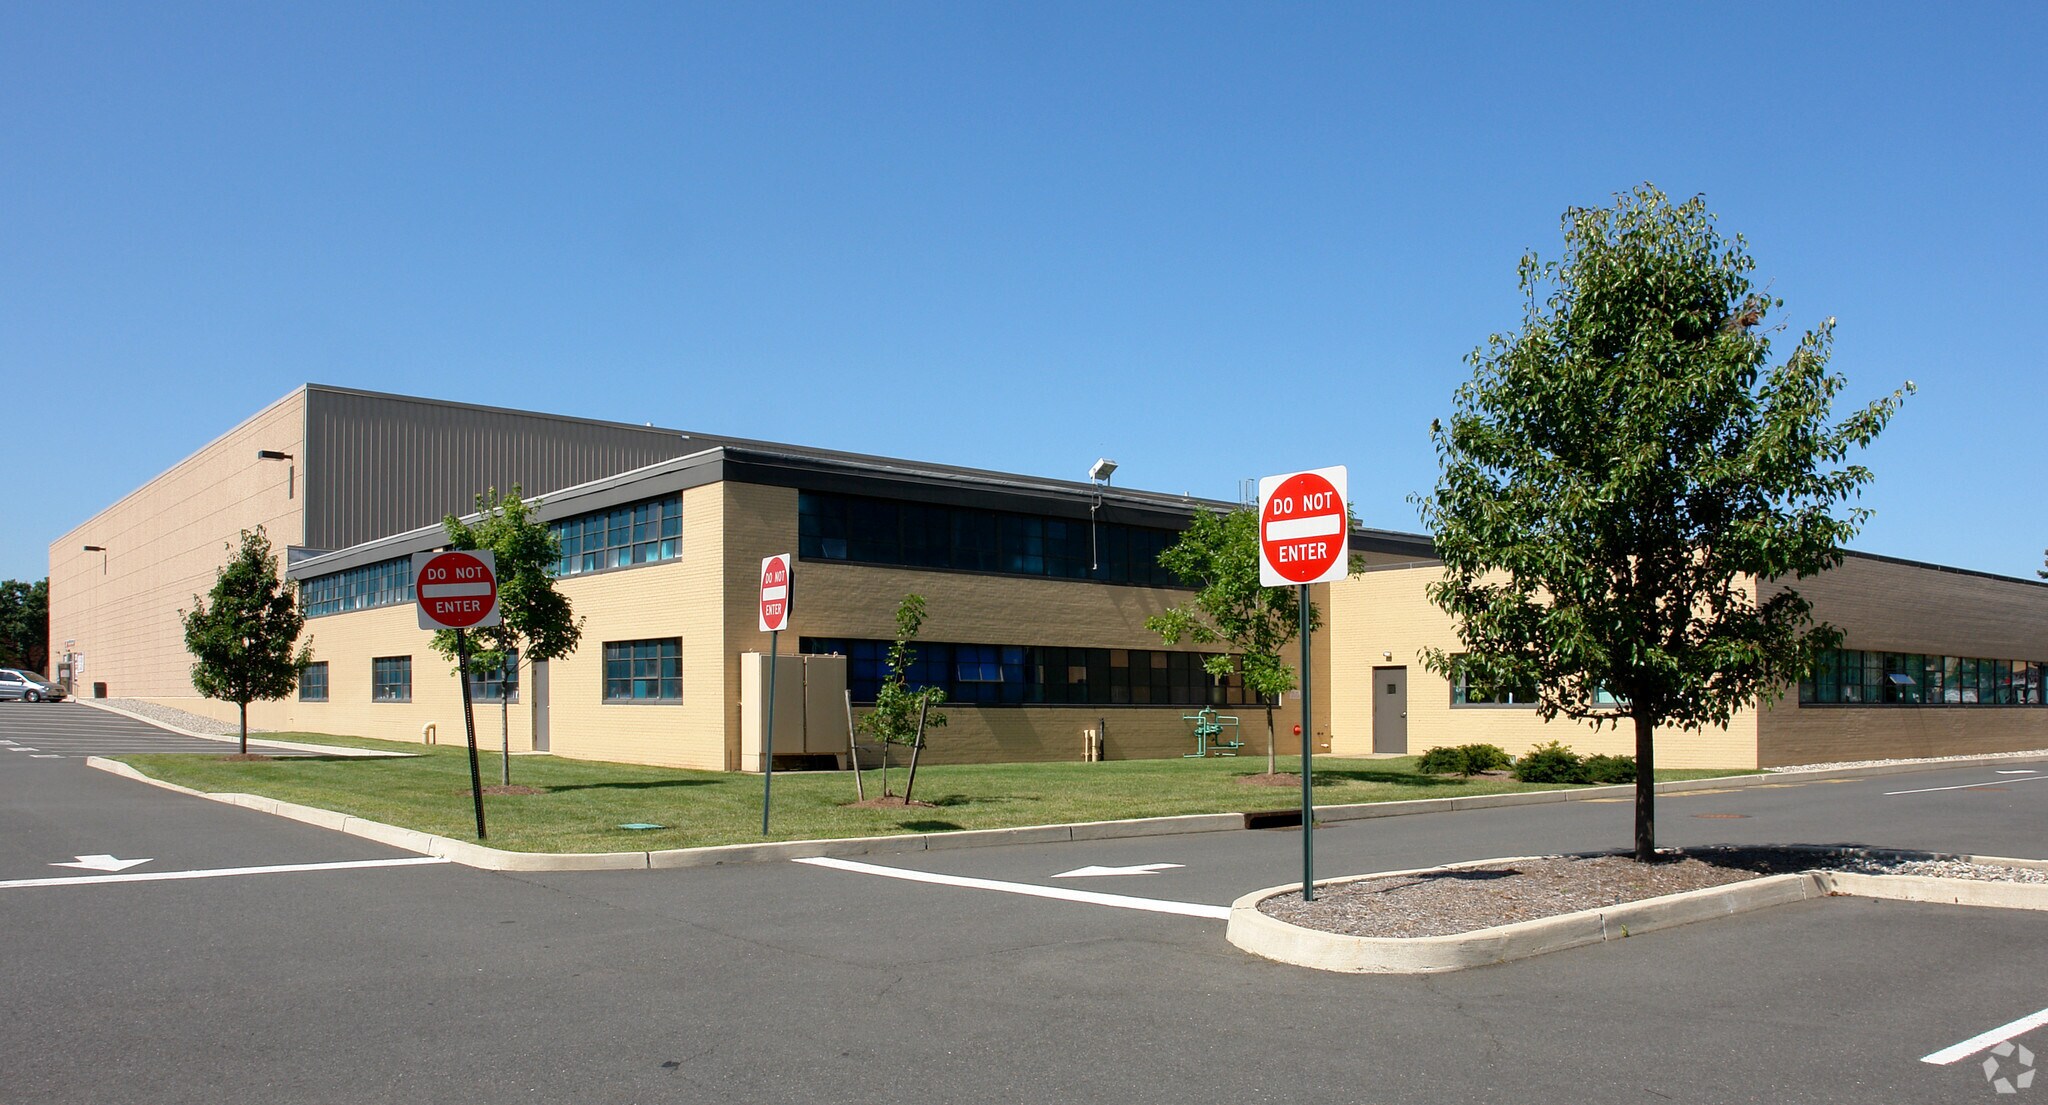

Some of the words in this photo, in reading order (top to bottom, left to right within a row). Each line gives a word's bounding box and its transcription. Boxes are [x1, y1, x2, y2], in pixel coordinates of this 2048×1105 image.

[1273, 497, 1293, 515] DO
[1303, 491, 1333, 512] NOT
[1279, 542, 1327, 563] ENTER
[427, 568, 446, 580] DO
[456, 566, 483, 579] NOT
[765, 572, 773, 584] DO
[774, 570, 785, 582] NOT
[436, 600, 481, 614] ENTER
[765, 603, 782, 616] ENTER
